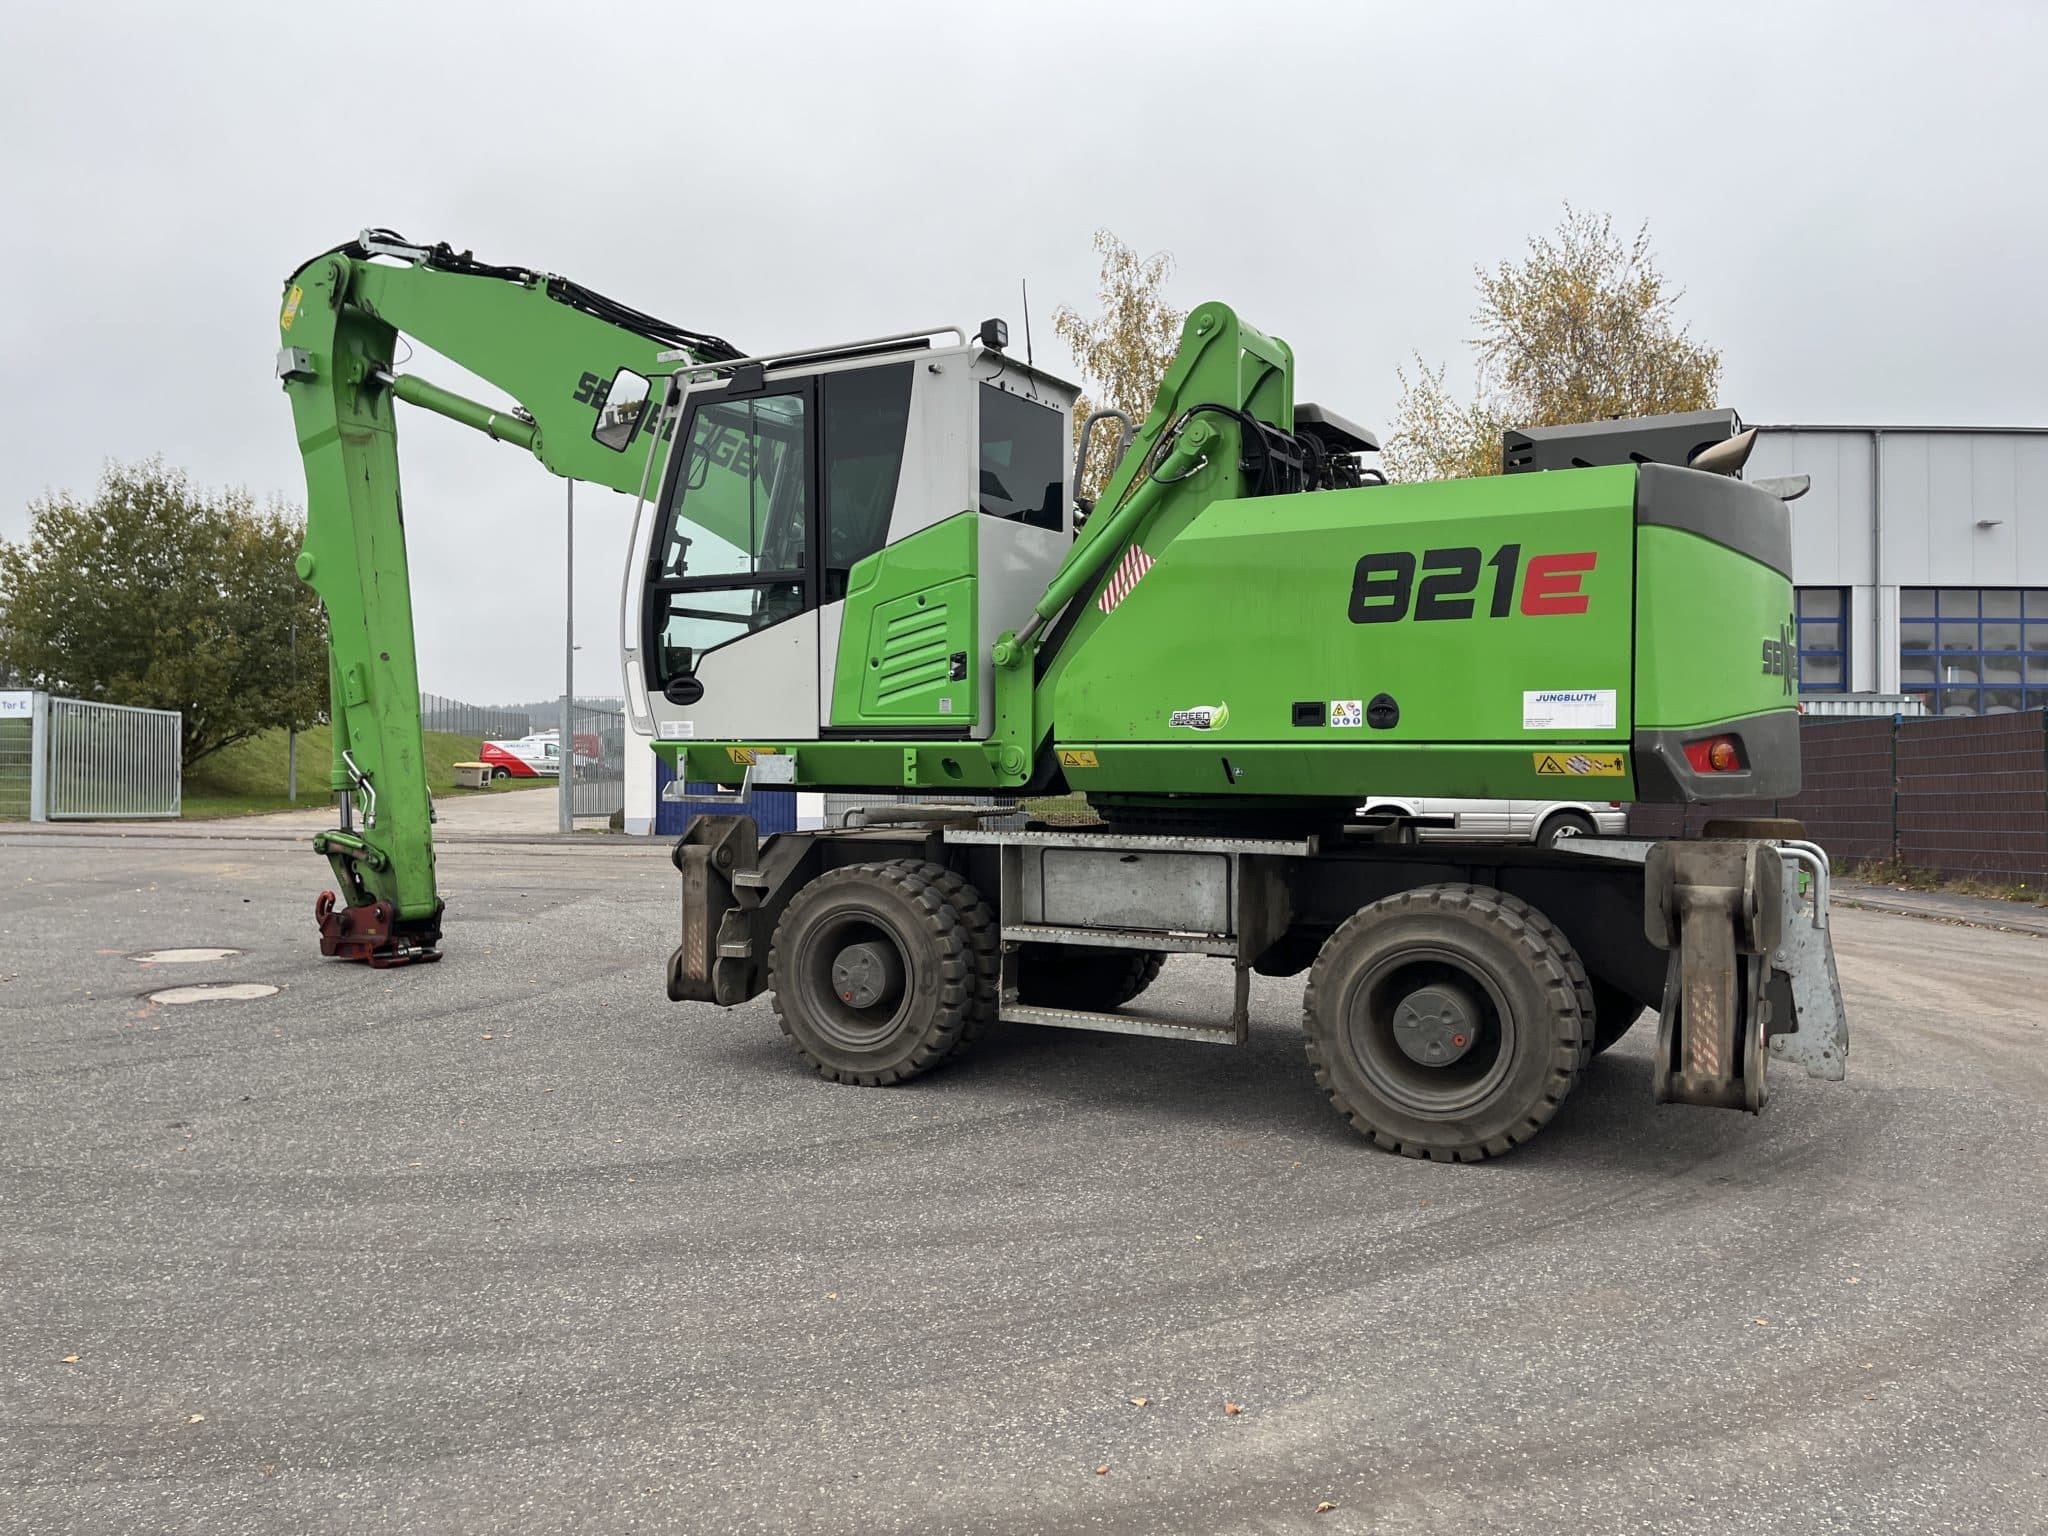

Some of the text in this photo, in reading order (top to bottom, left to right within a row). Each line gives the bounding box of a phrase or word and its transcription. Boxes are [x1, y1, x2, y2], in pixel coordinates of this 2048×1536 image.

[1348, 544, 1597, 624] 821E
[1536, 694, 1596, 702] JUNGBLUTH
[1173, 712, 1209, 720] GREEN
